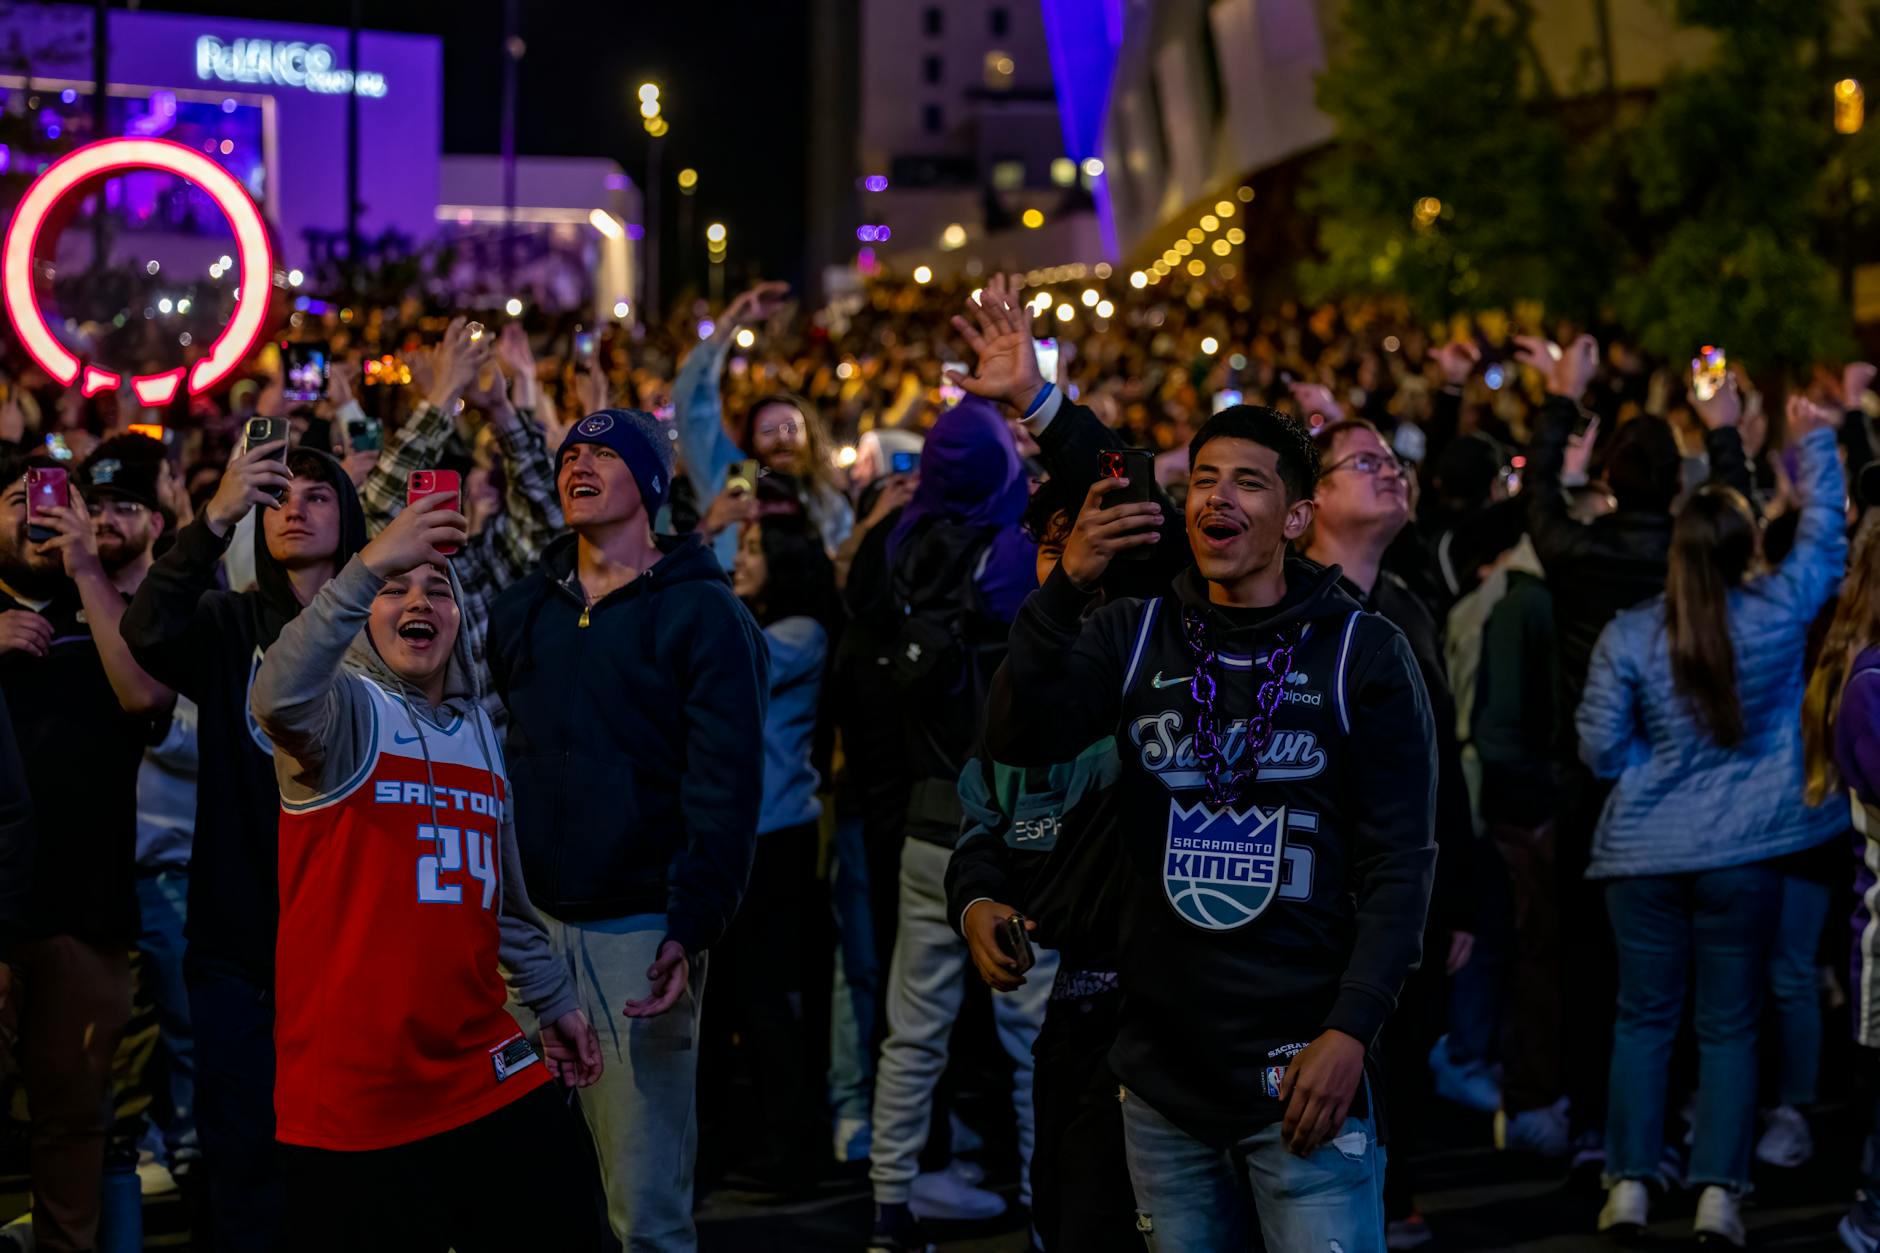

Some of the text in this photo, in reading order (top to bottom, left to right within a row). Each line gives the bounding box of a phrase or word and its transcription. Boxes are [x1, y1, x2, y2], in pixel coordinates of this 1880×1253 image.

[1282, 689, 1322, 706] alpad
[1128, 709, 1328, 776] Satwn
[1172, 837, 1273, 854] SACRAMENTO
[416, 823, 497, 912] 24
[1166, 852, 1275, 884] KINGS
